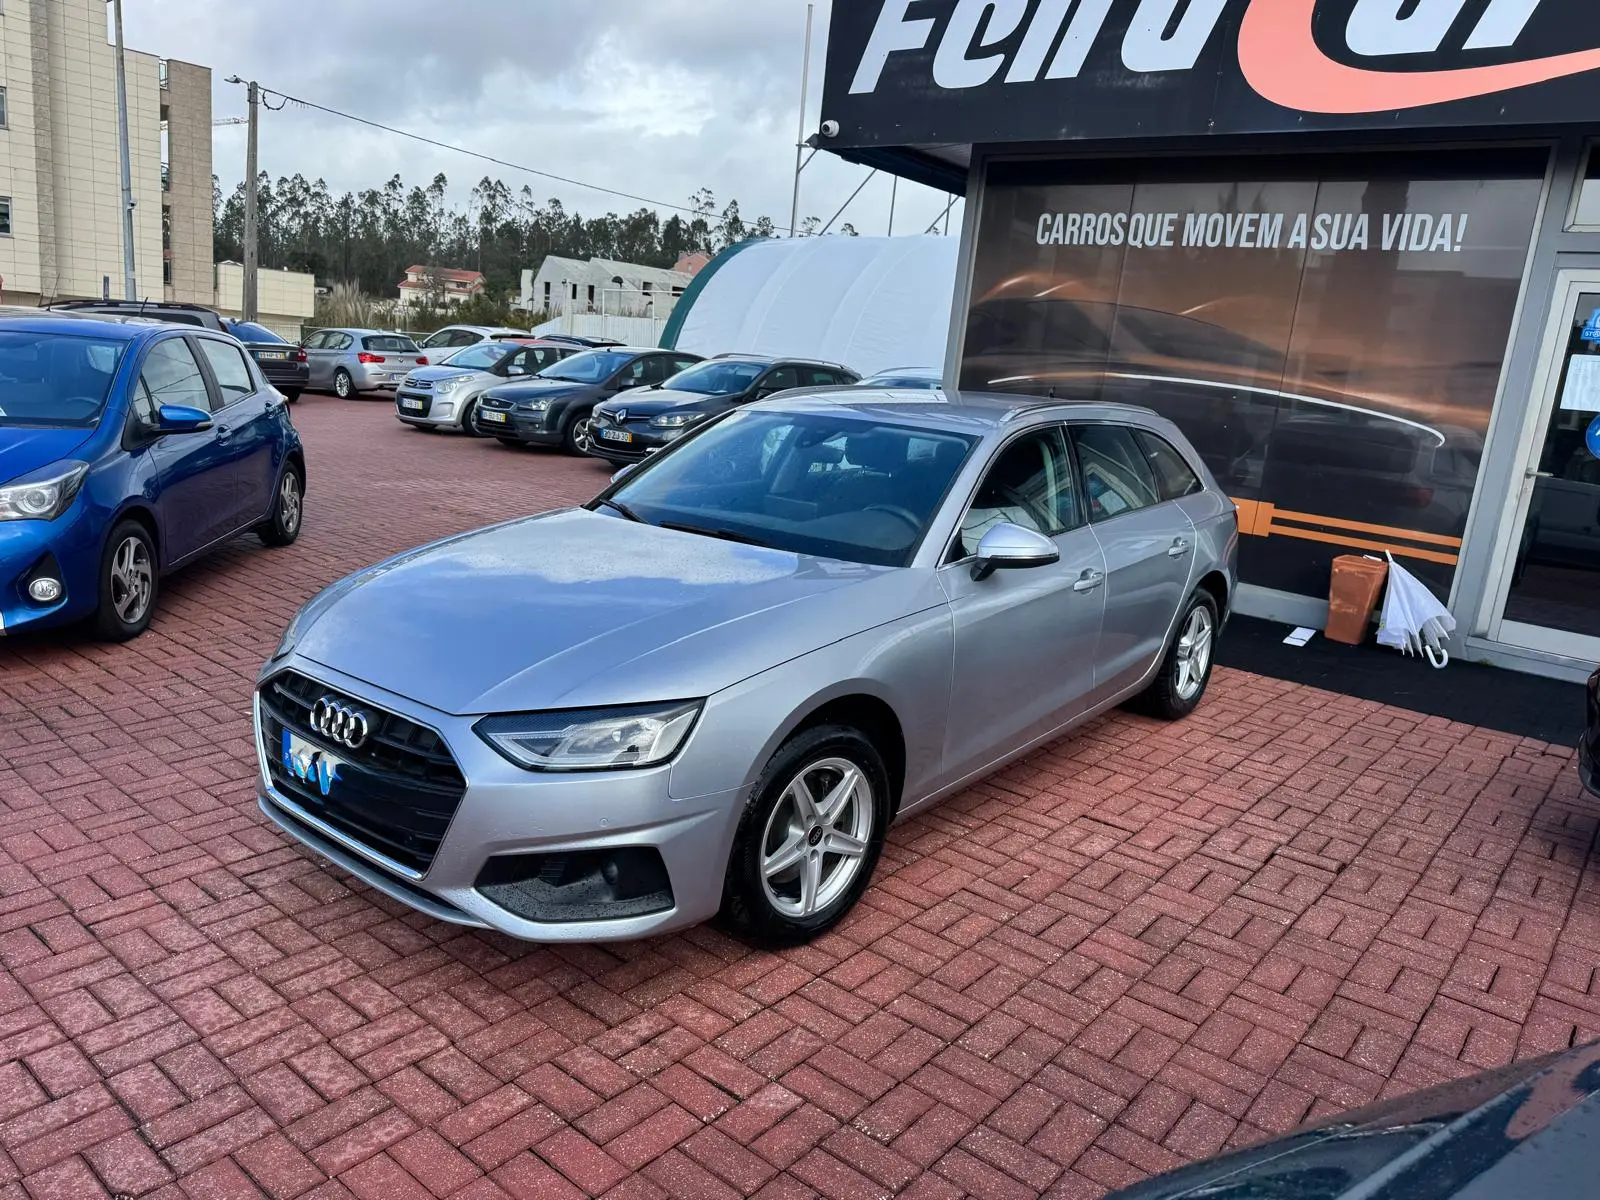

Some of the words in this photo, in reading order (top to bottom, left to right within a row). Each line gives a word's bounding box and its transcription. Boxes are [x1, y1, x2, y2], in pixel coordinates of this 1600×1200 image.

[1036, 213, 1127, 246] CARROS
[1128, 213, 1177, 248] QUE
[1182, 213, 1283, 248] MOVEM
[1287, 213, 1307, 249] A
[1311, 213, 1369, 250] SUA
[1381, 213, 1468, 251] VIDA!
